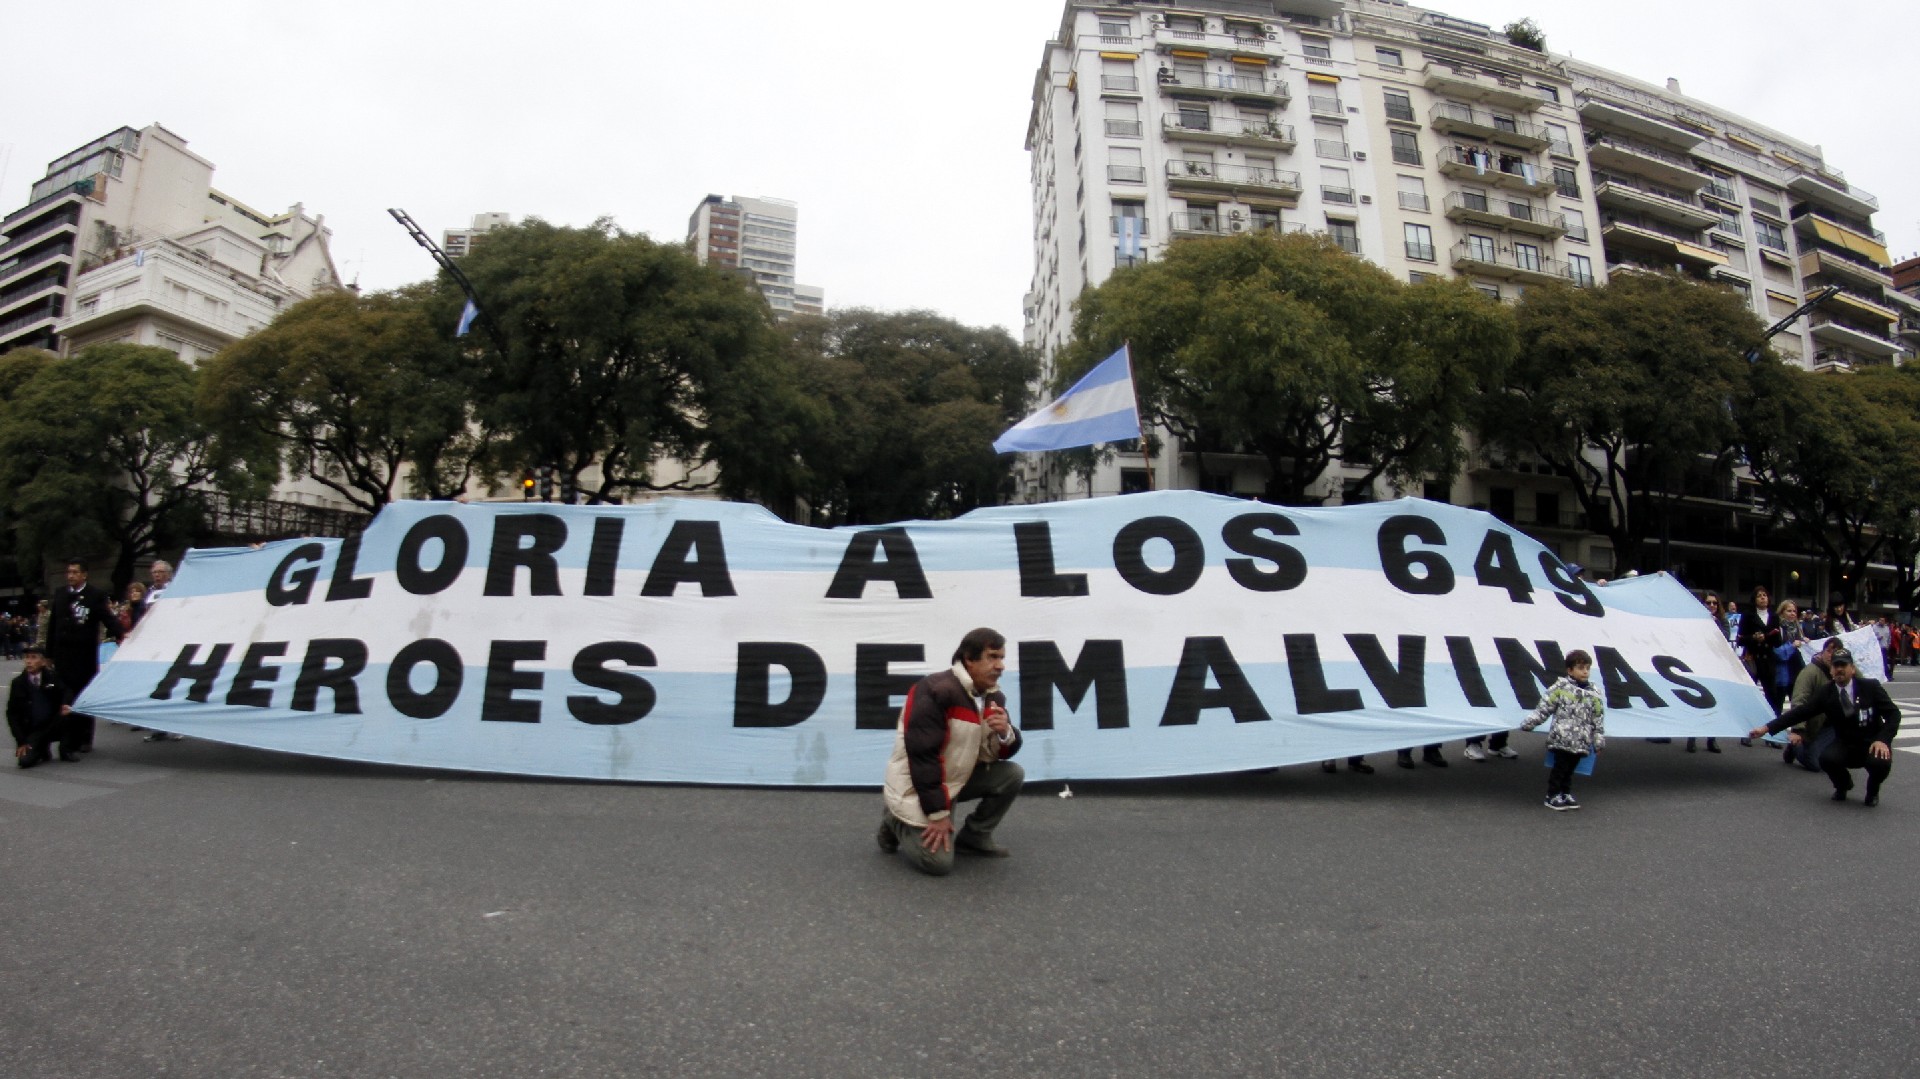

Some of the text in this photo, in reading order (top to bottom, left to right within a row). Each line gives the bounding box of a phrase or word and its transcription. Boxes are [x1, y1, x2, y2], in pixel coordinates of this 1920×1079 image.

[266, 512, 1606, 618] GLORIA A LOS 649
[149, 633, 1718, 733] HEROES DE MALVINAS
